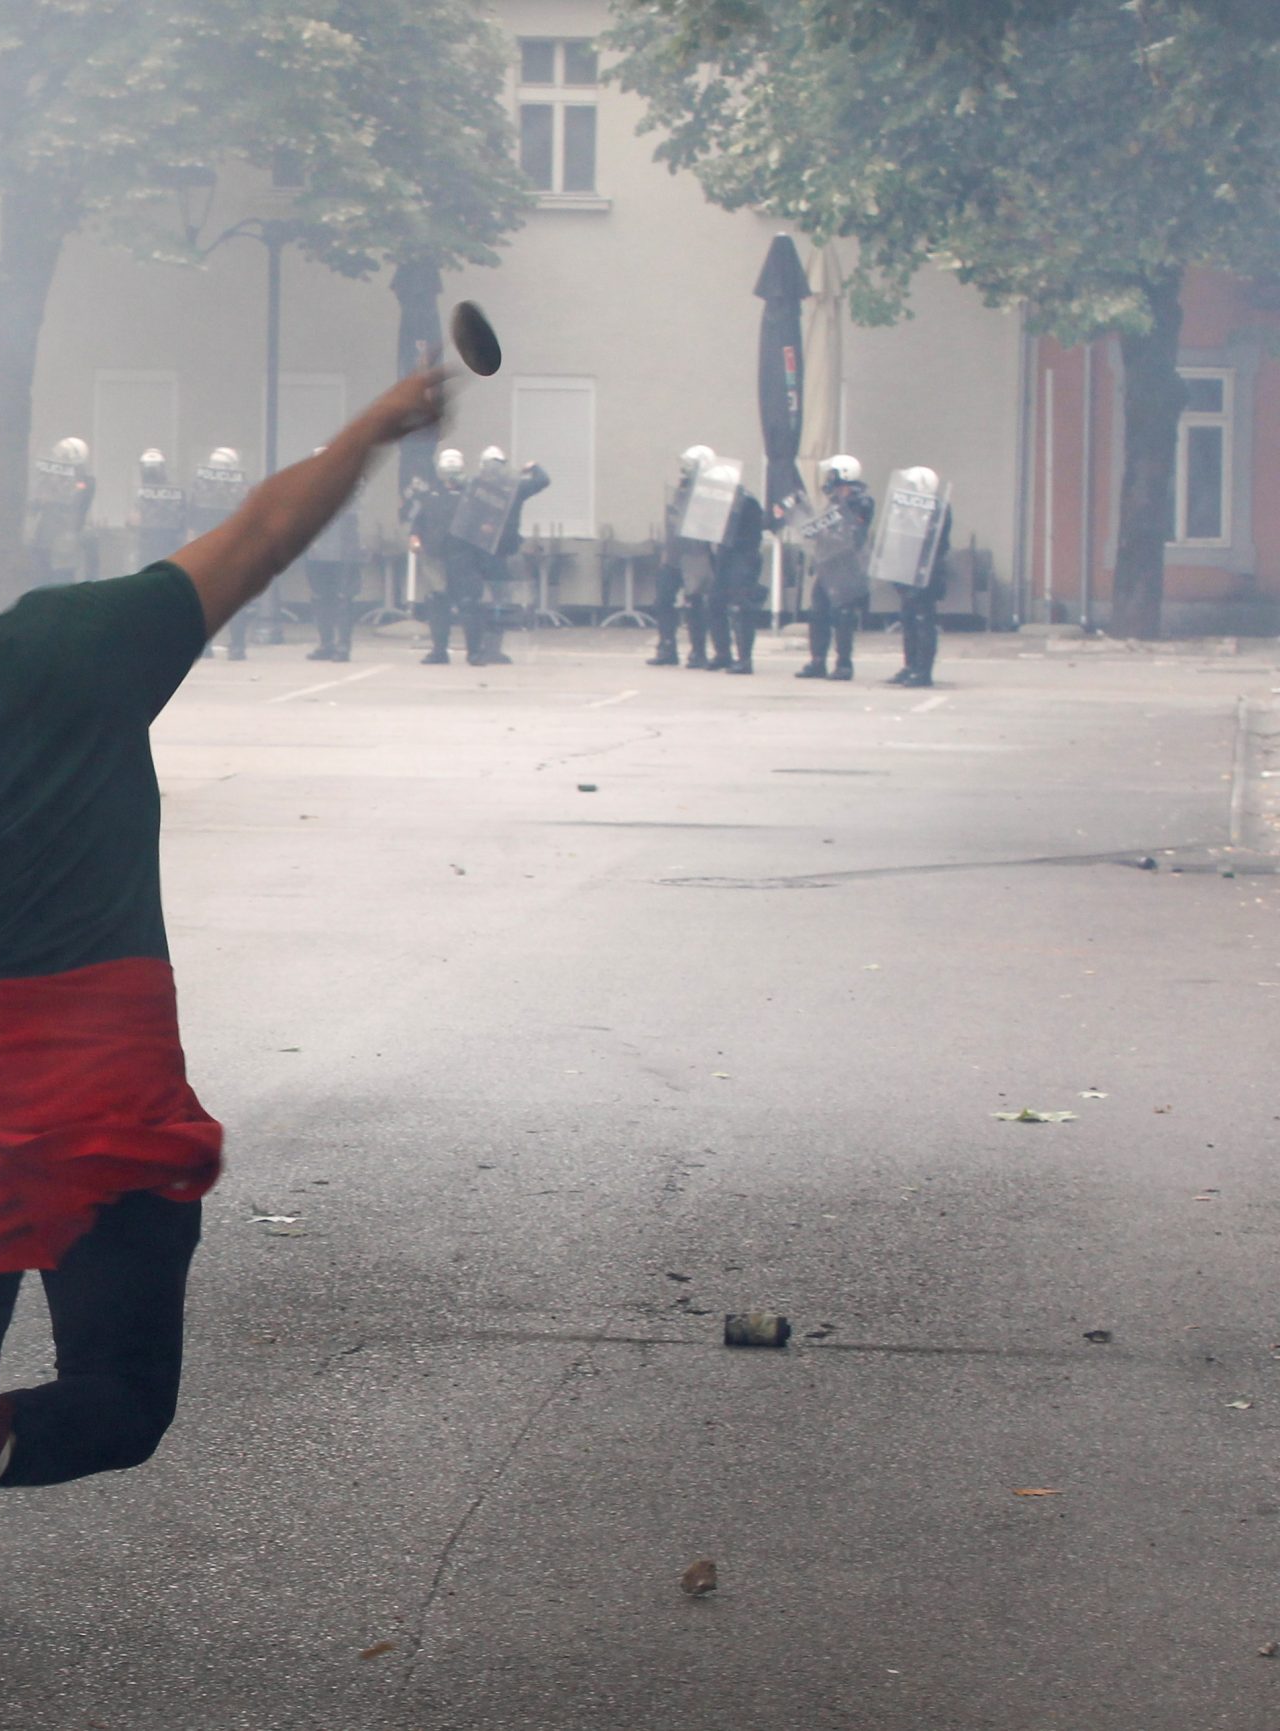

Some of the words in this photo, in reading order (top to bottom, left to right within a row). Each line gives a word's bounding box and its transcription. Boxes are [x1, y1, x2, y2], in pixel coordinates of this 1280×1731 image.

[195, 468, 242, 482] POLICIJA
[137, 488, 182, 500] POLICIJA
[893, 492, 936, 510] POLICIJA
